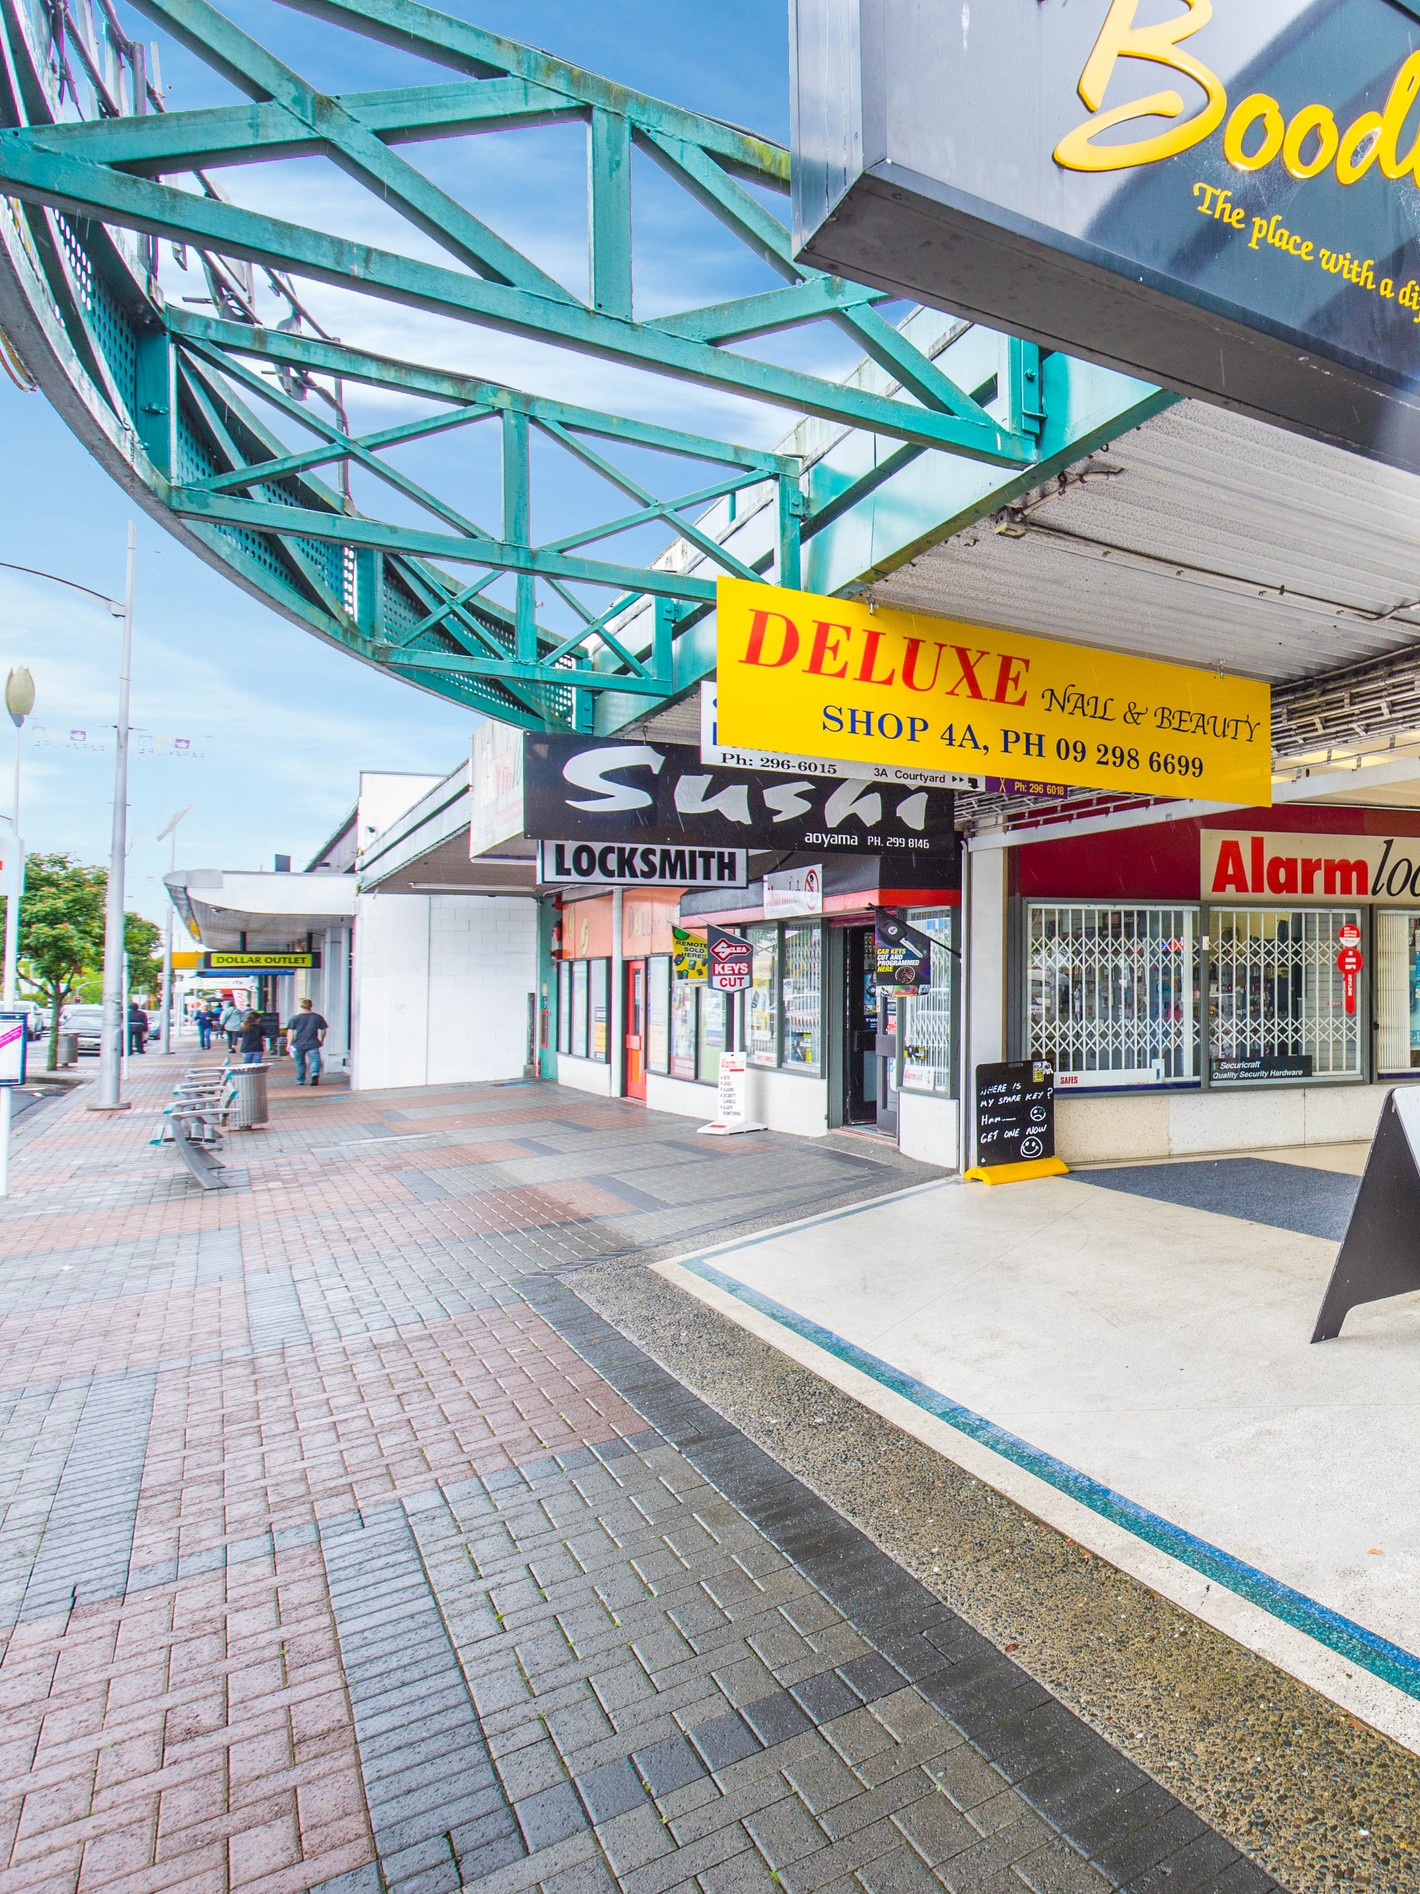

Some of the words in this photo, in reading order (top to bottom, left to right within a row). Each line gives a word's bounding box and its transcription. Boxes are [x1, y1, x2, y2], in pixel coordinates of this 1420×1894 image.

[1193, 182, 1246, 229] The
[1251, 214, 1314, 261] place
[1319, 249, 1376, 290] with
[1379, 278, 1394, 299] a
[738, 608, 1030, 707] DELUXE
[1041, 683, 1116, 723] NAIL
[1122, 701, 1149, 725] &
[1153, 706, 1260, 743] BEAUTY
[821, 704, 929, 743] SHOP
[940, 722, 990, 757] 4A,
[1000, 728, 1045, 758] PH
[1056, 737, 1087, 763] 09
[1095, 743, 1139, 771] 298
[1147, 750, 1204, 779] 6699
[721, 752, 753, 767] Ph:
[760, 757, 837, 774] 296-6015
[874, 767, 888, 778] 3A
[894, 769, 945, 784] Courtyard
[562, 745, 928, 830] Sushi
[1014, 782, 1027, 793] Ph:
[1029, 784, 1044, 794] 296
[1047, 786, 1065, 796] 6018
[804, 831, 859, 848] aoyama
[867, 835, 884, 847] PH.
[886, 837, 905, 847] 299
[908, 837, 930, 848] 8146
[555, 843, 736, 882] LOCKSMITH
[217, 956, 262, 964] DOLLAR
[264, 956, 307, 964] OUTLET
[714, 963, 749, 974] KEYS
[720, 977, 744, 987] CUT
[1220, 1061, 1261, 1070] Securicraft
[1060, 1076, 1078, 1084] SAFES
[1212, 1072, 1238, 1080] Quality
[1239, 1070, 1268, 1079] Security
[1012, 1082, 1021, 1091] IS
[980, 1099, 994, 1108] MY
[998, 1095, 1021, 1105] SPARE
[1025, 1092, 1044, 1101] KEY
[981, 1130, 998, 1144] GET
[1004, 1128, 1020, 1138] ONE
[1026, 1125, 1048, 1136] NOW
